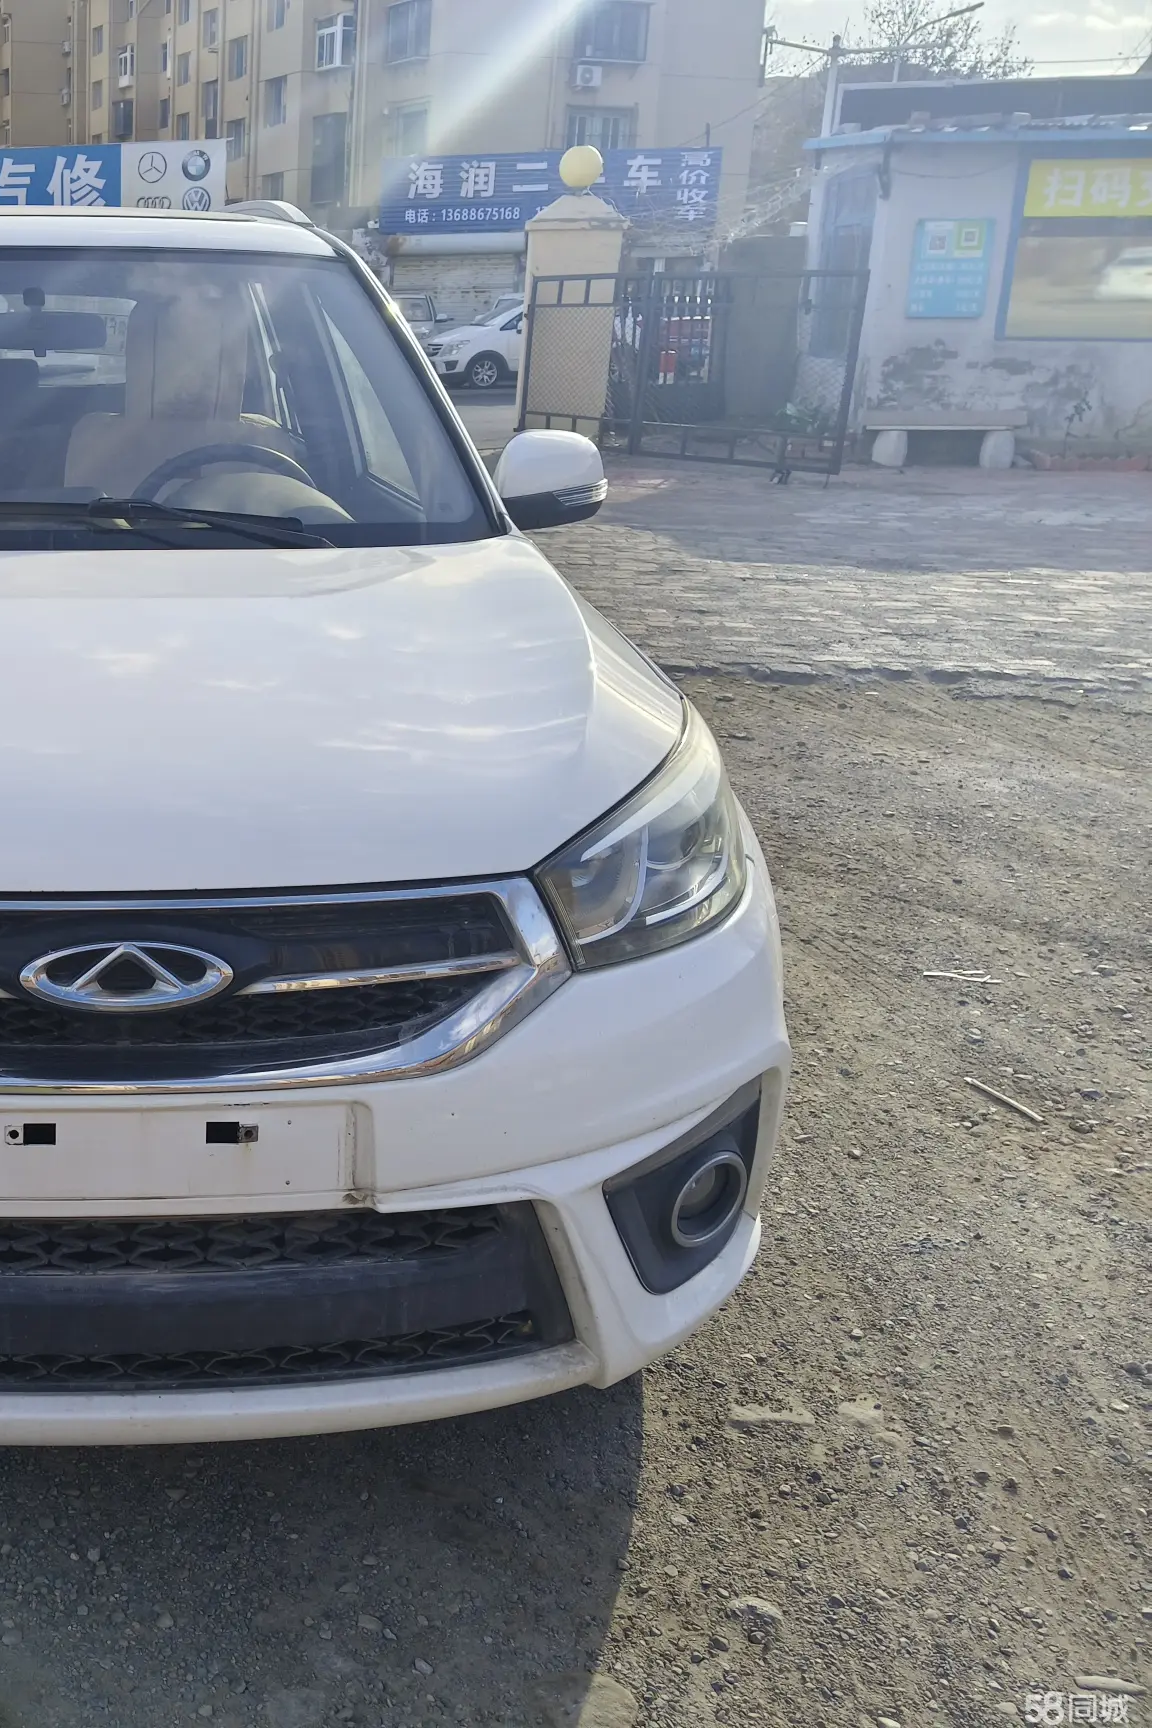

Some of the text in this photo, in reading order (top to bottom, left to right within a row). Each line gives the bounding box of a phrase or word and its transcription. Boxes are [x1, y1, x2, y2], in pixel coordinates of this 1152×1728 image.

[408, 155, 662, 199] 海润二车
[673, 152, 714, 220] 高价收车
